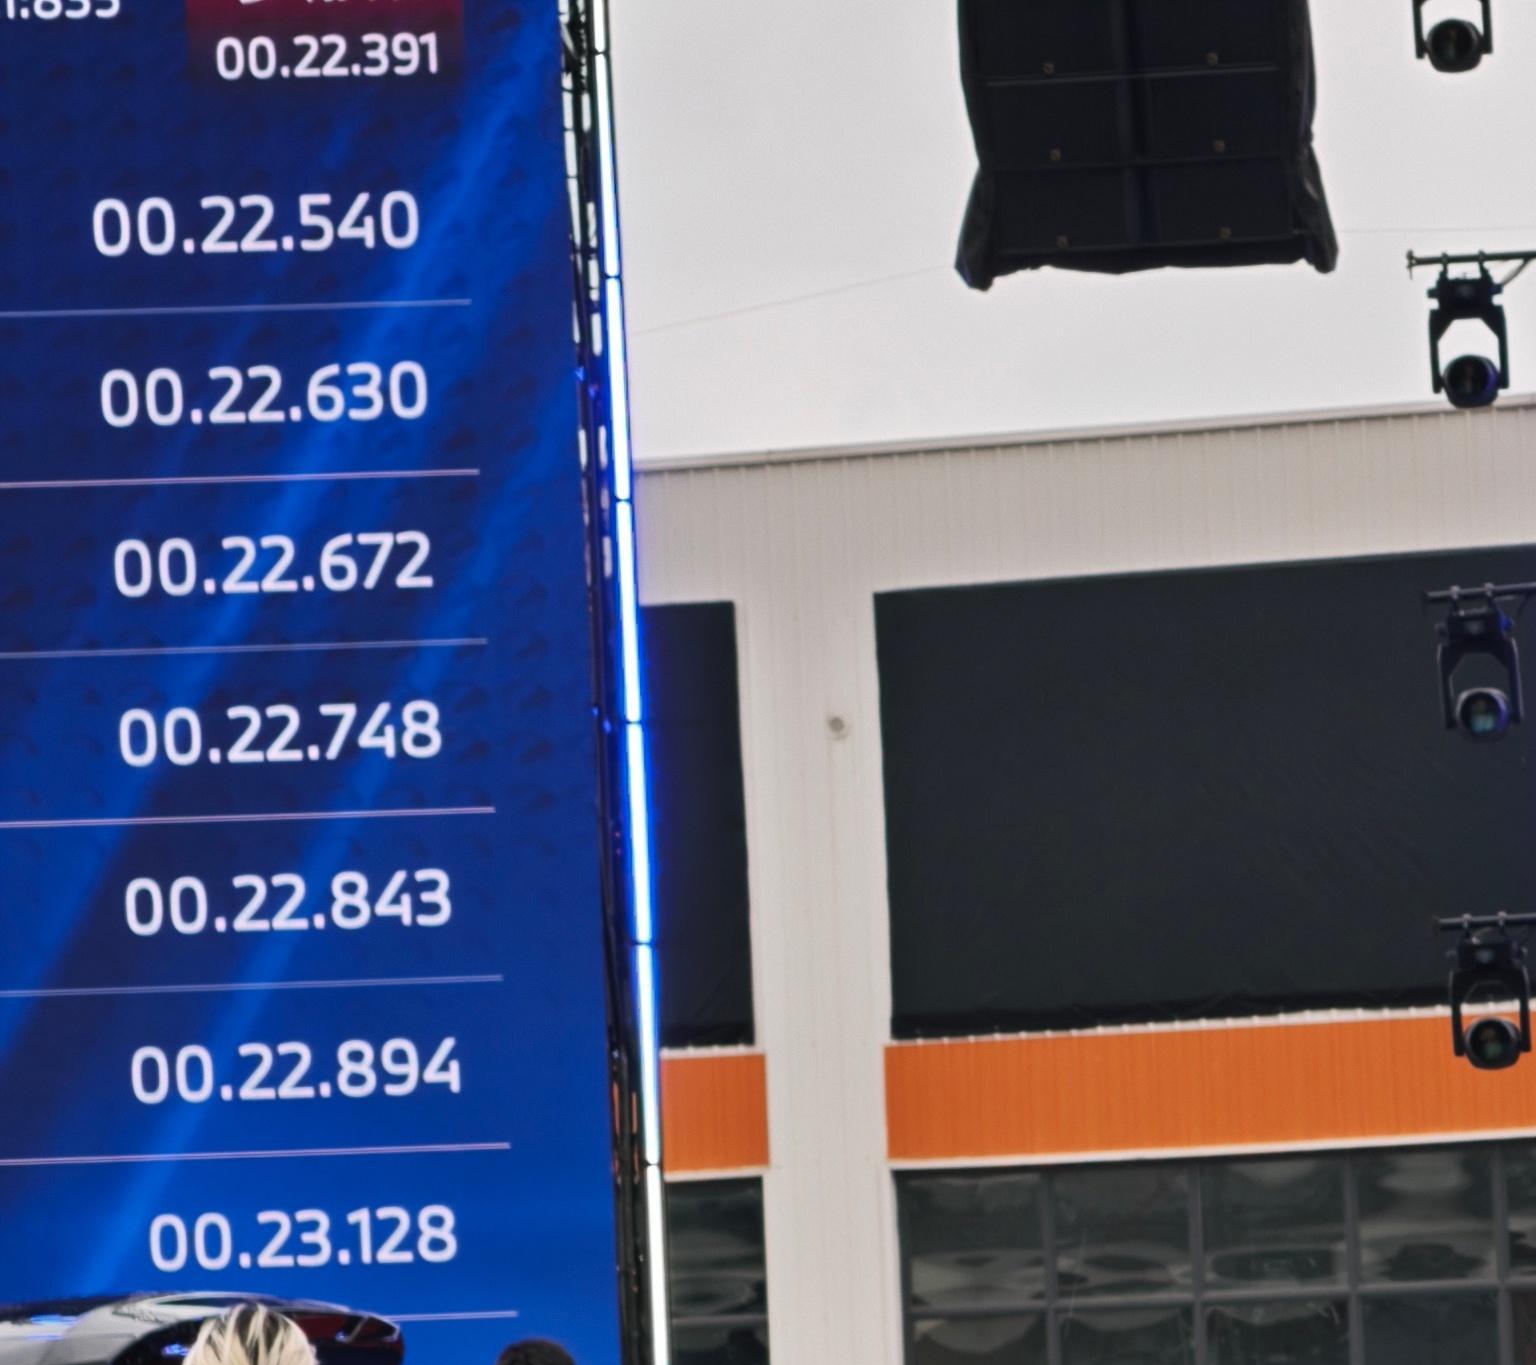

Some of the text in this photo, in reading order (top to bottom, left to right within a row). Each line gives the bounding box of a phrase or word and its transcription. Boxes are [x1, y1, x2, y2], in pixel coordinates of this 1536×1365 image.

[215, 32, 439, 80] 00.22.391
[92, 190, 420, 257] 00.22.540
[100, 360, 428, 427] 00.22.630
[113, 530, 434, 597] 00.22.672
[118, 699, 442, 767] 00.22.748
[124, 868, 452, 936] 00.22.843
[130, 1037, 461, 1104] 00.22.894
[148, 1204, 458, 1272] 00.23.128
